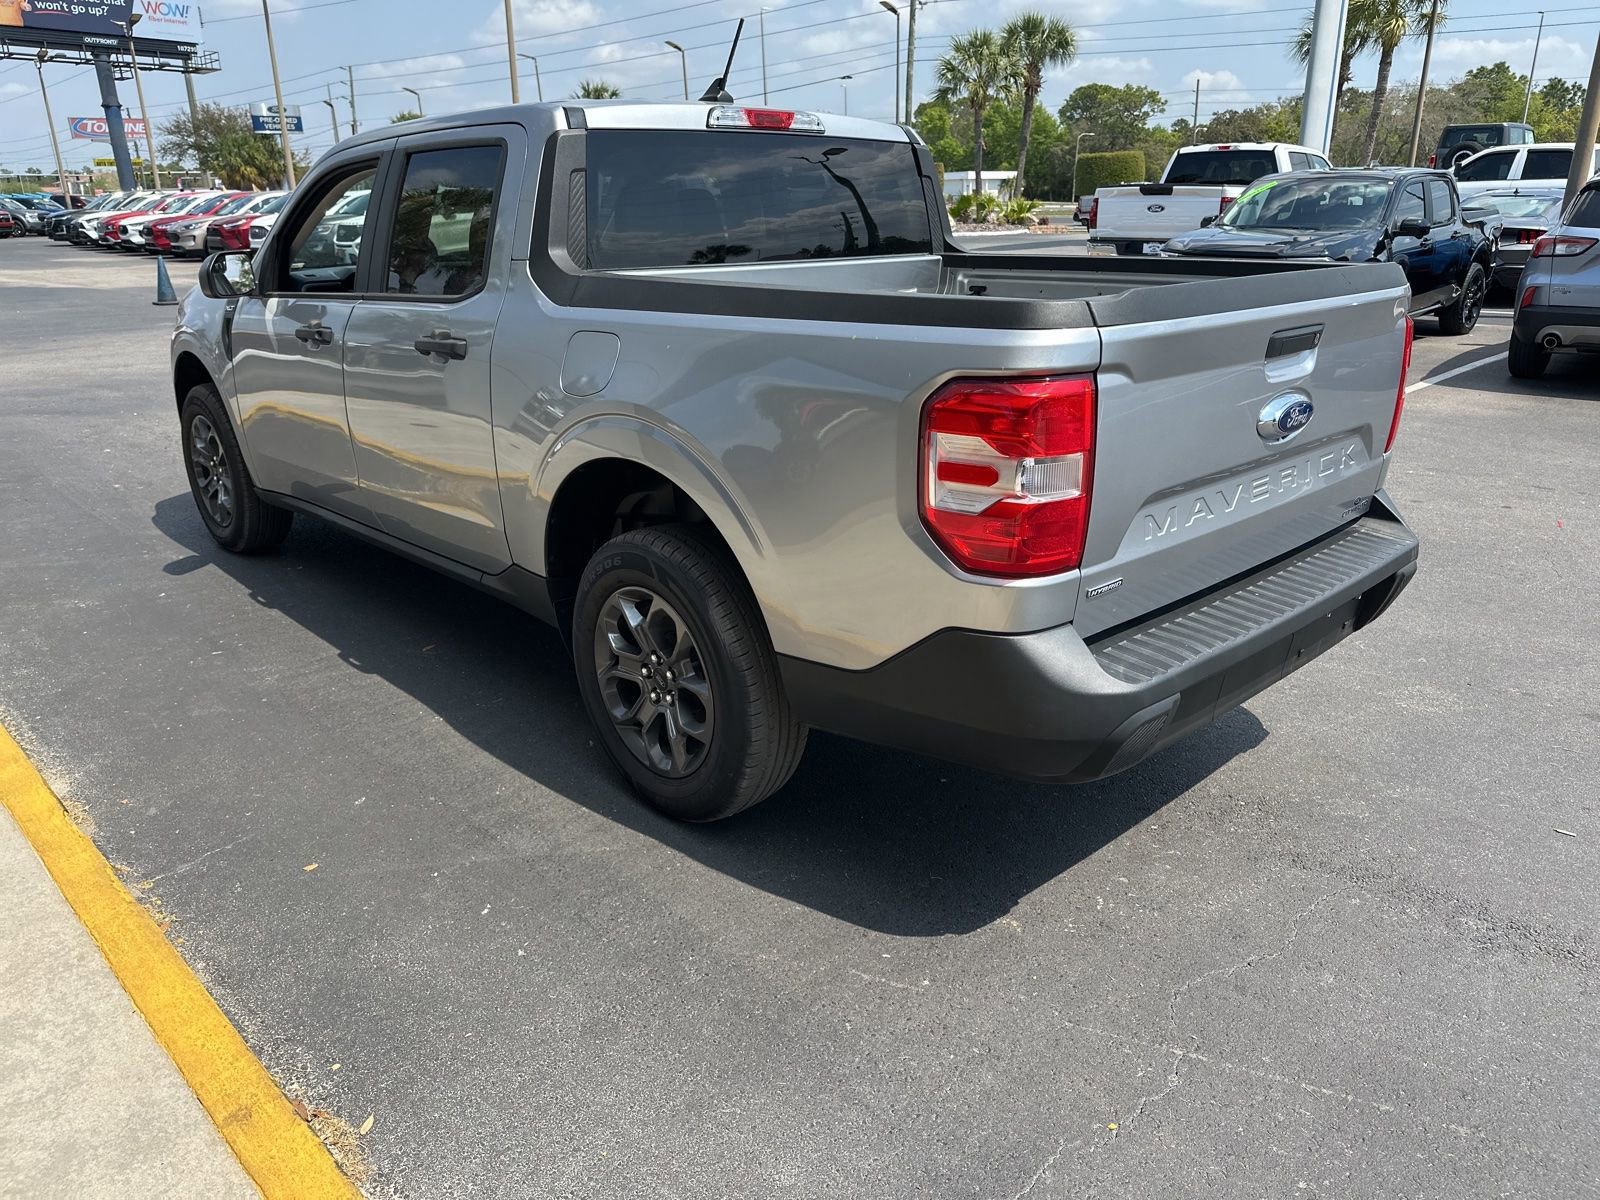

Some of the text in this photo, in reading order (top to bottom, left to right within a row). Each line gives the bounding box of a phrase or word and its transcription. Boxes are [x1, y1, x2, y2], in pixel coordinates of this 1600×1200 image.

[34, 0, 109, 16] won't go up?
[140, 0, 189, 18] WOW!
[259, 116, 298, 124] PRE-ONED
[1285, 403, 1311, 430] Ford
[1144, 444, 1356, 541] MAVERICK
[1090, 579, 1123, 598] HYBRID
